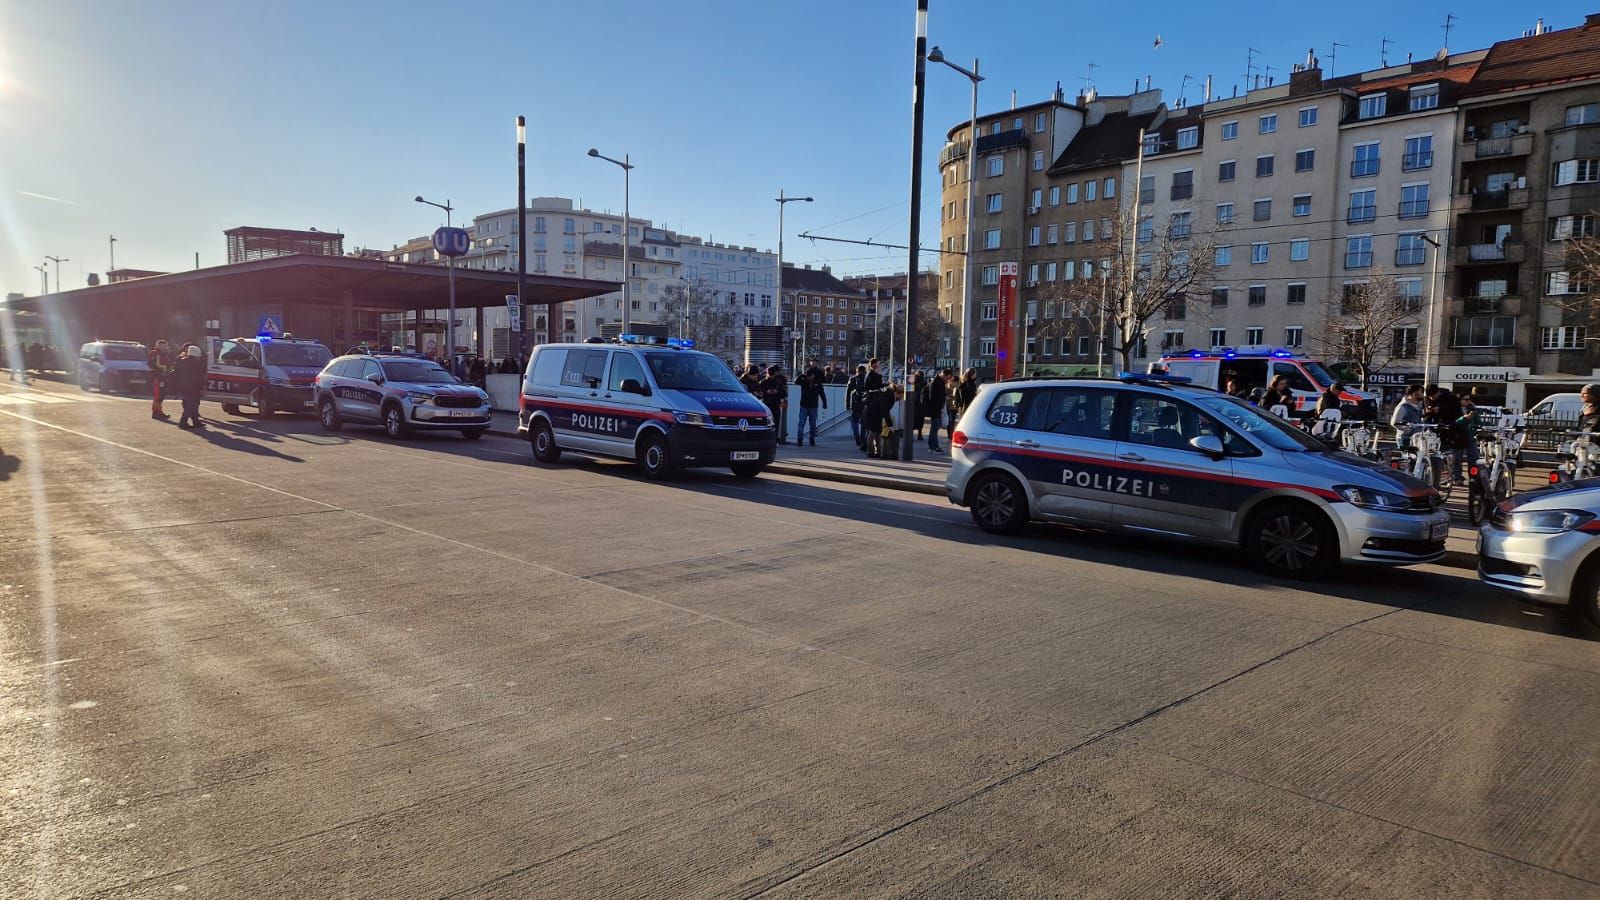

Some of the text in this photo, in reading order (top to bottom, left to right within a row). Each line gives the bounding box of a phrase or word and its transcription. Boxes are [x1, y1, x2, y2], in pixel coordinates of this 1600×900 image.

[435, 231, 447, 250] U
[453, 232, 467, 252] U
[208, 380, 231, 390] ZEI
[342, 389, 364, 400] POLIZEI
[571, 413, 618, 432] POLIZEI
[1000, 412, 1018, 425] 133
[1062, 469, 1153, 497] POLIZEI
